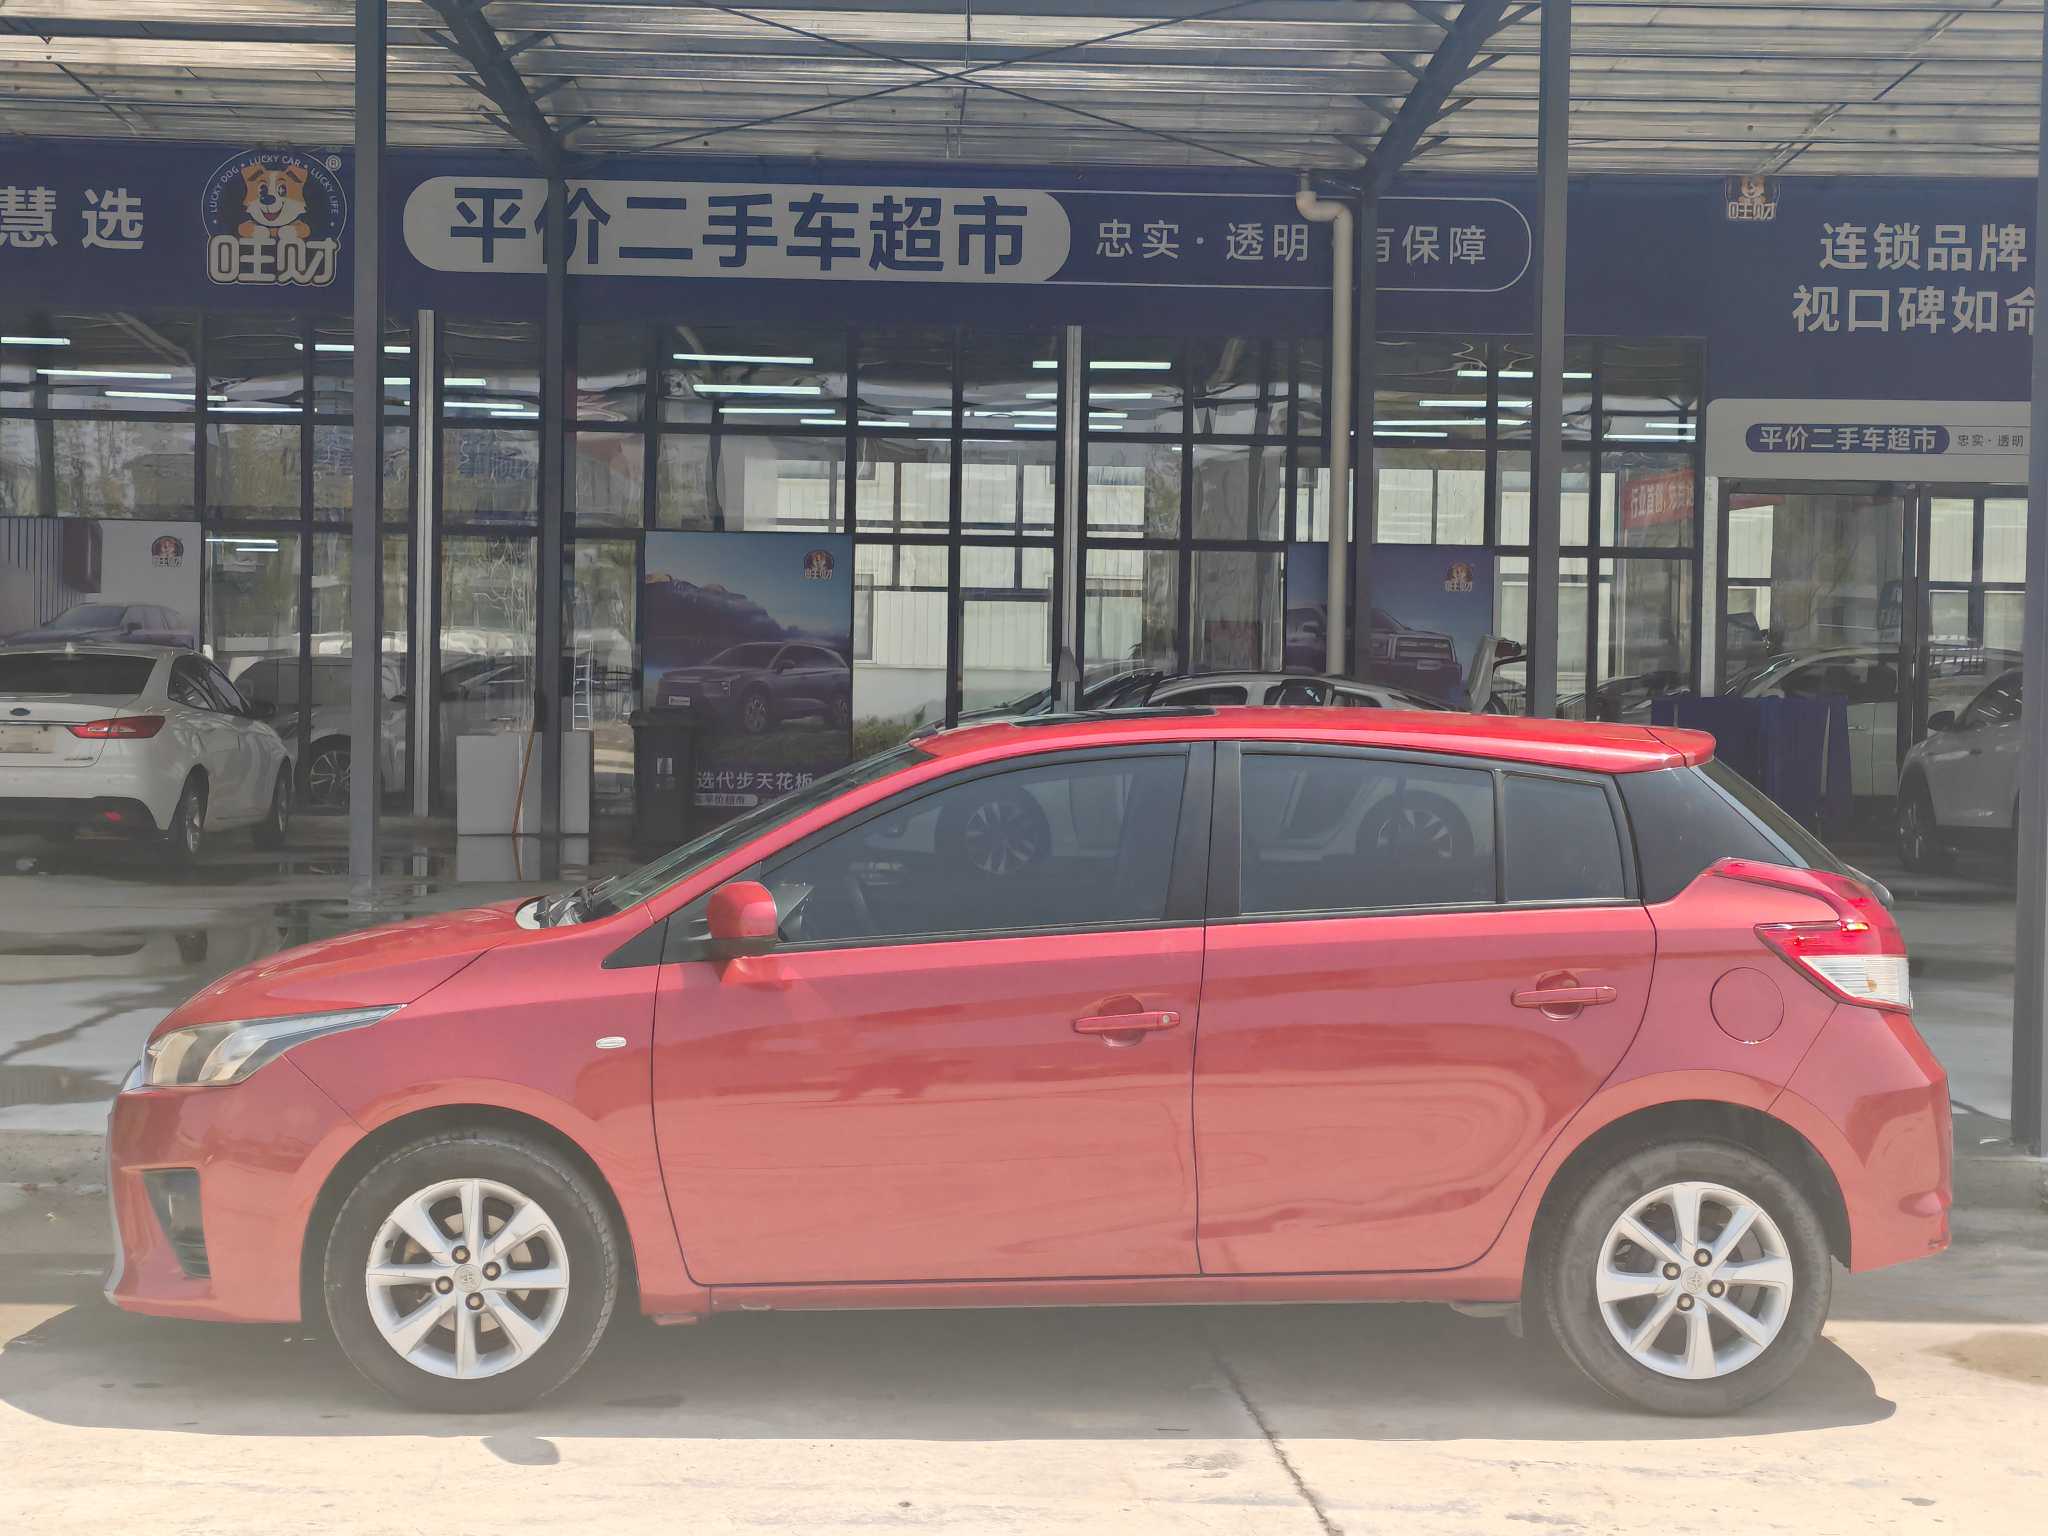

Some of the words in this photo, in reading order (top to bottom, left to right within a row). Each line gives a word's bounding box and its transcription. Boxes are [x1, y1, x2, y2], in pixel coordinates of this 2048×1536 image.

[249, 155, 279, 166] LUCKY
[282, 155, 301, 167] CAR
[208, 183, 221, 213] LUCKY
[221, 166, 239, 183] DOG
[311, 167, 334, 192] LUCKY
[329, 195, 339, 216] LIFE
[450, 186, 1028, 275] 平价二手车超市
[1819, 222, 2027, 272] 连锁品牌
[1792, 284, 2034, 336] 视口碑如命
[1759, 426, 1937, 453] 平价二手车超市
